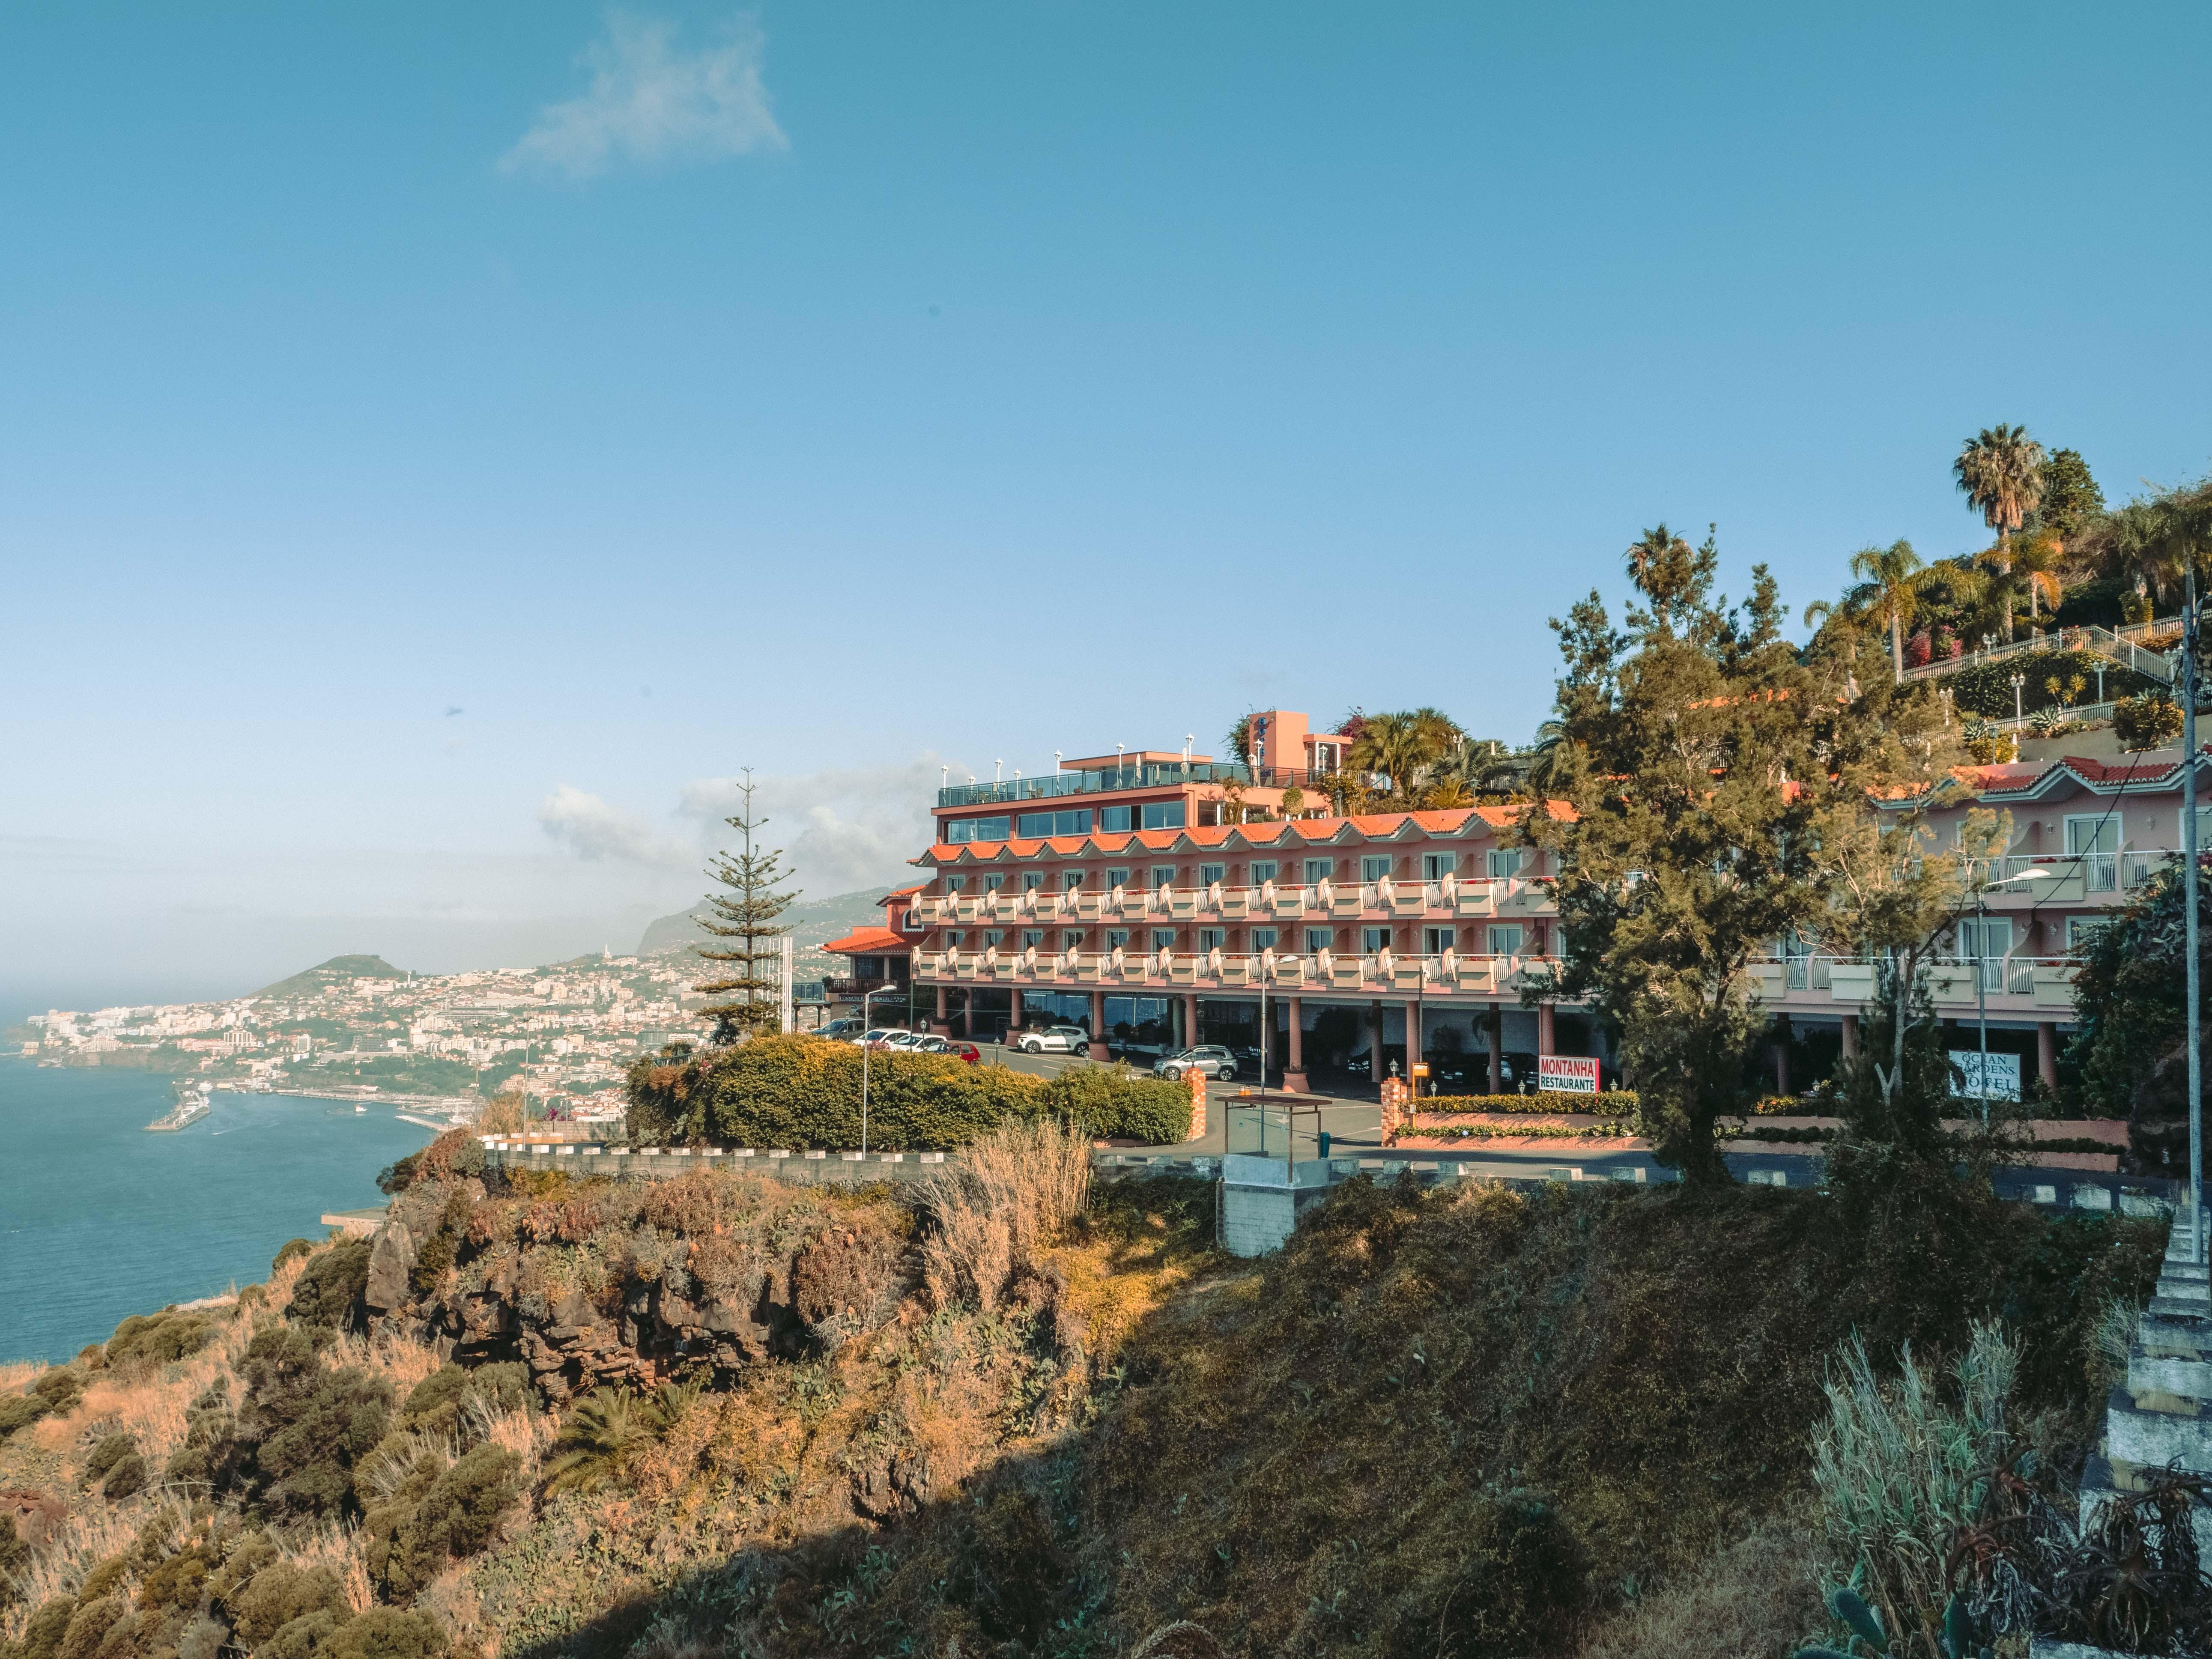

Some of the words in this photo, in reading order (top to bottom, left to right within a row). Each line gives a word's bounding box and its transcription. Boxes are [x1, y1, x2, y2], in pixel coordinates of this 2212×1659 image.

[1962, 1053, 2007, 1065] OCAN
[1541, 1059, 1594, 1077] MONTANHA
[1541, 1076, 1594, 1091] RESTAURANTE
[1968, 1076, 2013, 1090] OTEL
